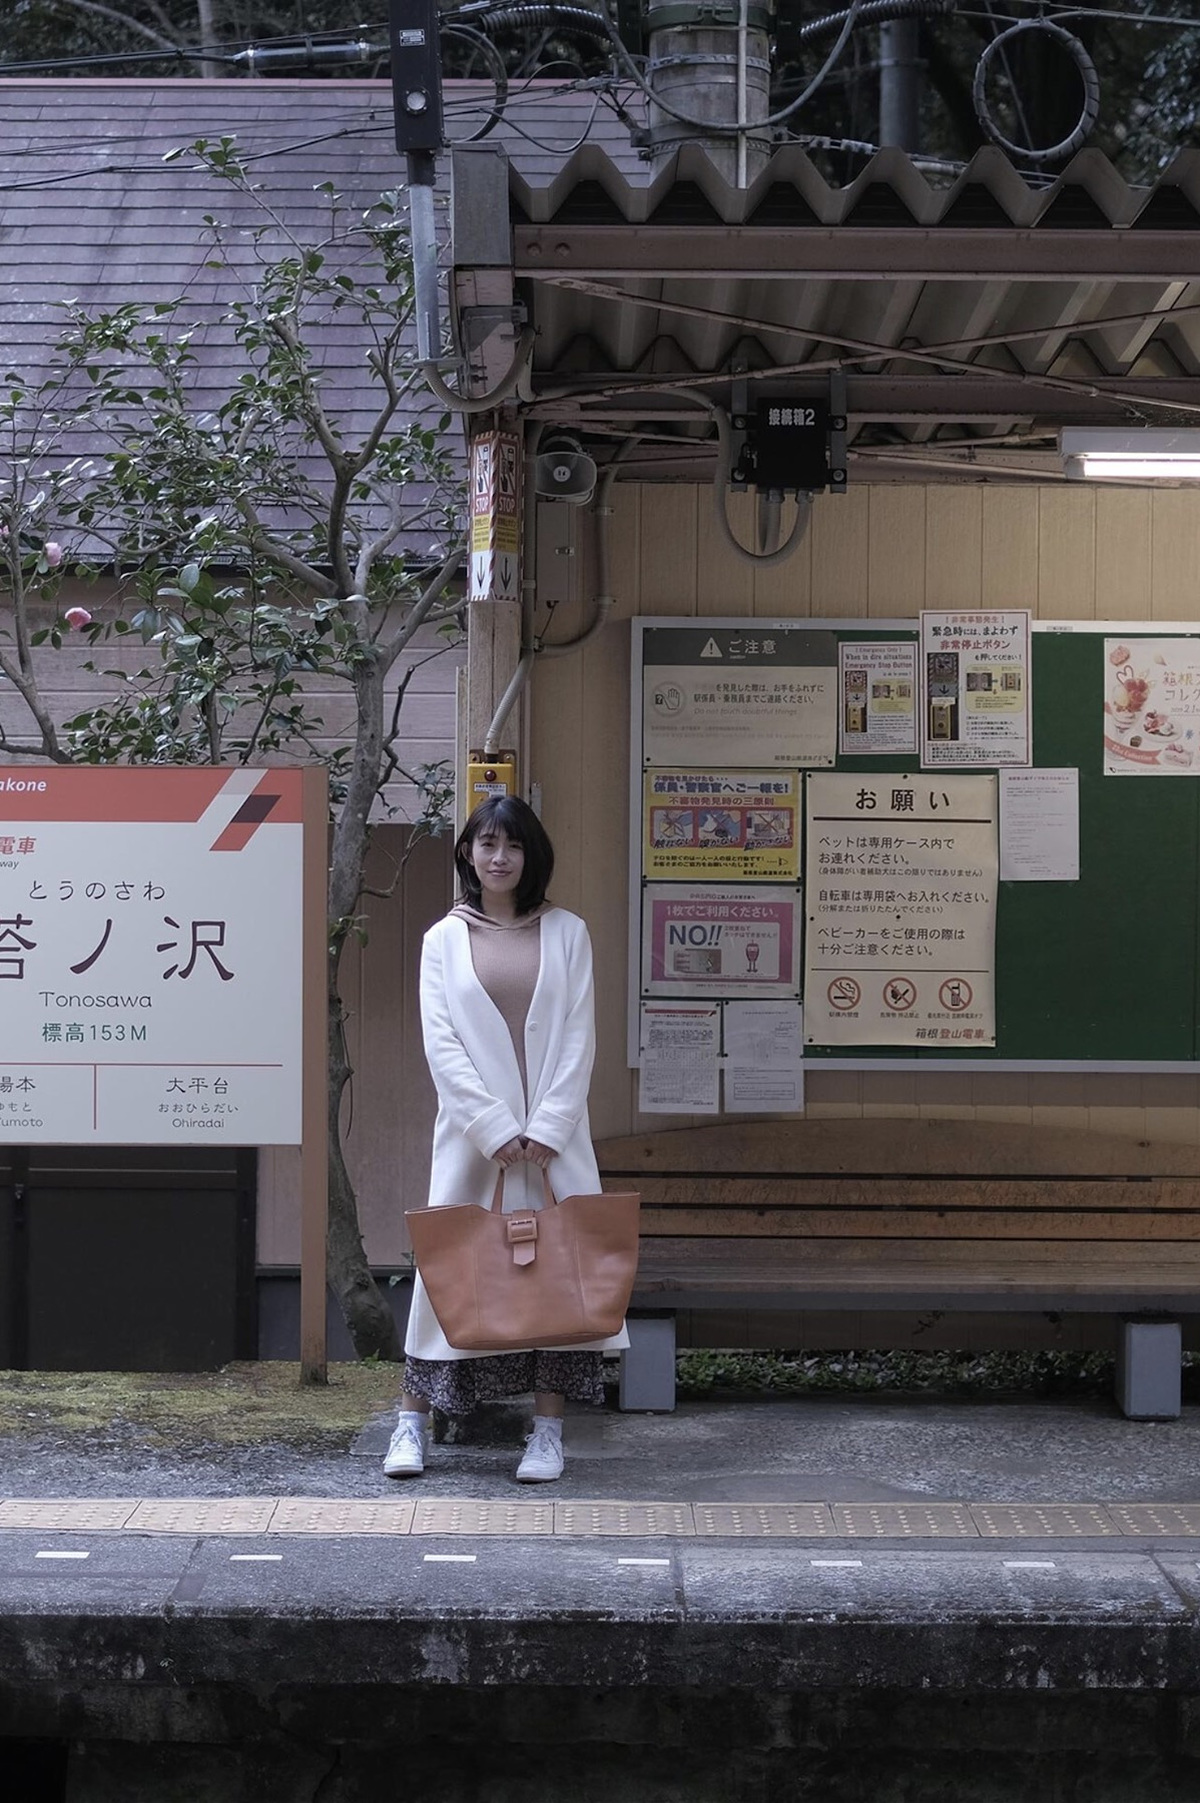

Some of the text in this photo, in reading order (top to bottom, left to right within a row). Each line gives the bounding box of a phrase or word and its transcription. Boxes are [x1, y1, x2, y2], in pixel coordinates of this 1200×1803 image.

[476, 496, 489, 512] STOP
[499, 497, 515, 513] STOP
[931, 626, 1018, 637] 緊急時には、まよわず
[729, 639, 777, 654] ご注意
[940, 638, 1011, 650] 非常停止ボタン
[668, 796, 775, 806] 不審物発見時の三原則
[855, 788, 950, 812] お願い
[0, 836, 37, 855] 電車
[818, 836, 955, 849] ペットは専用ケース内で
[818, 852, 911, 865] お連れください。
[28, 880, 166, 901] とうのさわ
[818, 889, 990, 904] 自転車は専用袋へお入れください。
[665, 904, 779, 918] 1枚でご利用ください。
[669, 924, 723, 946] NO!!
[817, 927, 966, 941] ベビーカーをご使用の際は
[817, 943, 934, 957] 十分ご注意ください。
[39, 990, 153, 1009] Tonosawa
[42, 1022, 148, 1043] 標高153M
[914, 1027, 985, 1040] 箱根登山電車
[165, 1077, 230, 1095] 大平台
[158, 1102, 240, 1115] おおひらだい
[0, 1116, 44, 1128] umoto
[172, 1117, 226, 1130] Ohiradai
